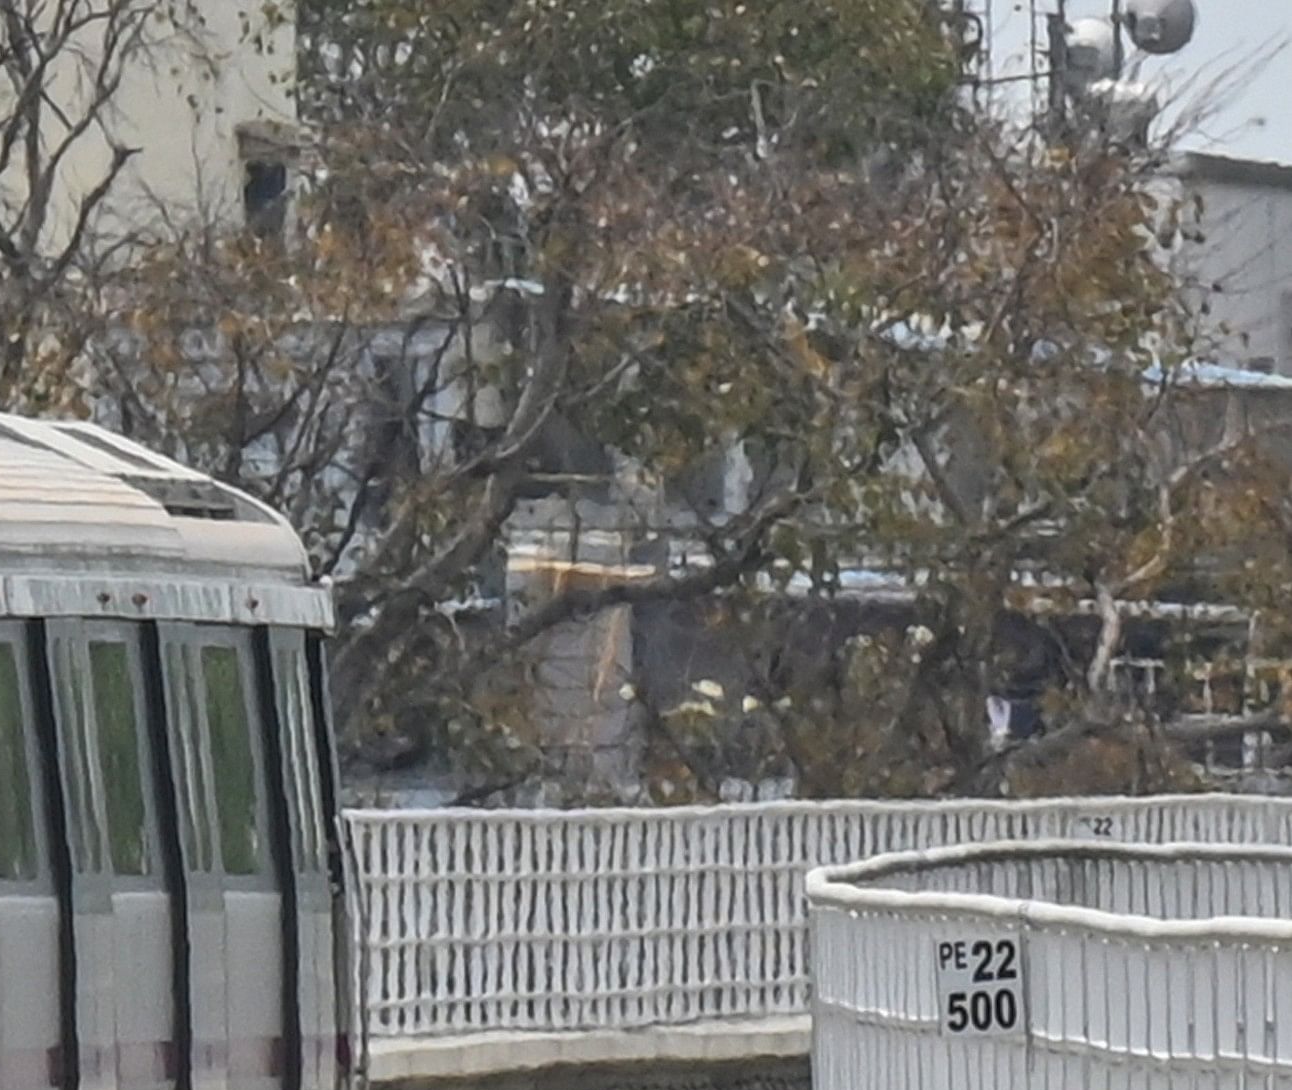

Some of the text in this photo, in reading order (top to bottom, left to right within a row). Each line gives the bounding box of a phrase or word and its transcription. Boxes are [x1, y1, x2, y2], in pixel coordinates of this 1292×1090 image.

[1092, 816, 1112, 835] 22
[938, 939, 1017, 983] PE 22
[947, 988, 1017, 1032] 500
